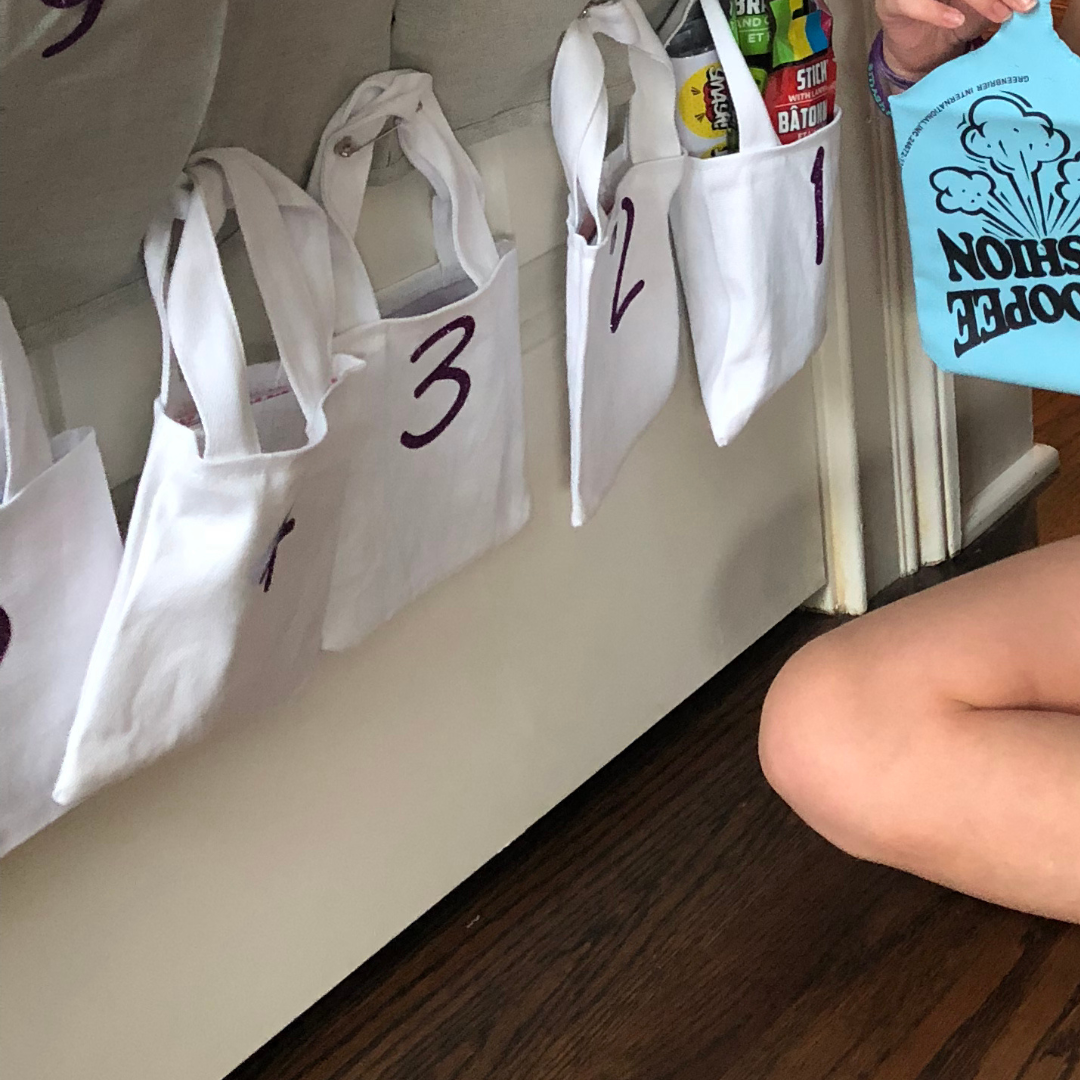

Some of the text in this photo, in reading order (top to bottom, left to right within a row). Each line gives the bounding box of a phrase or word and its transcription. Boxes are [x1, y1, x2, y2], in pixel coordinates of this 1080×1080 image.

[748, 32, 765, 43] ET
[788, 91, 811, 103] WITH
[976, 75, 1030, 92] GREENBRIER
[810, 146, 825, 266] 1
[609, 196, 646, 334] 2
[401, 315, 476, 451] 3
